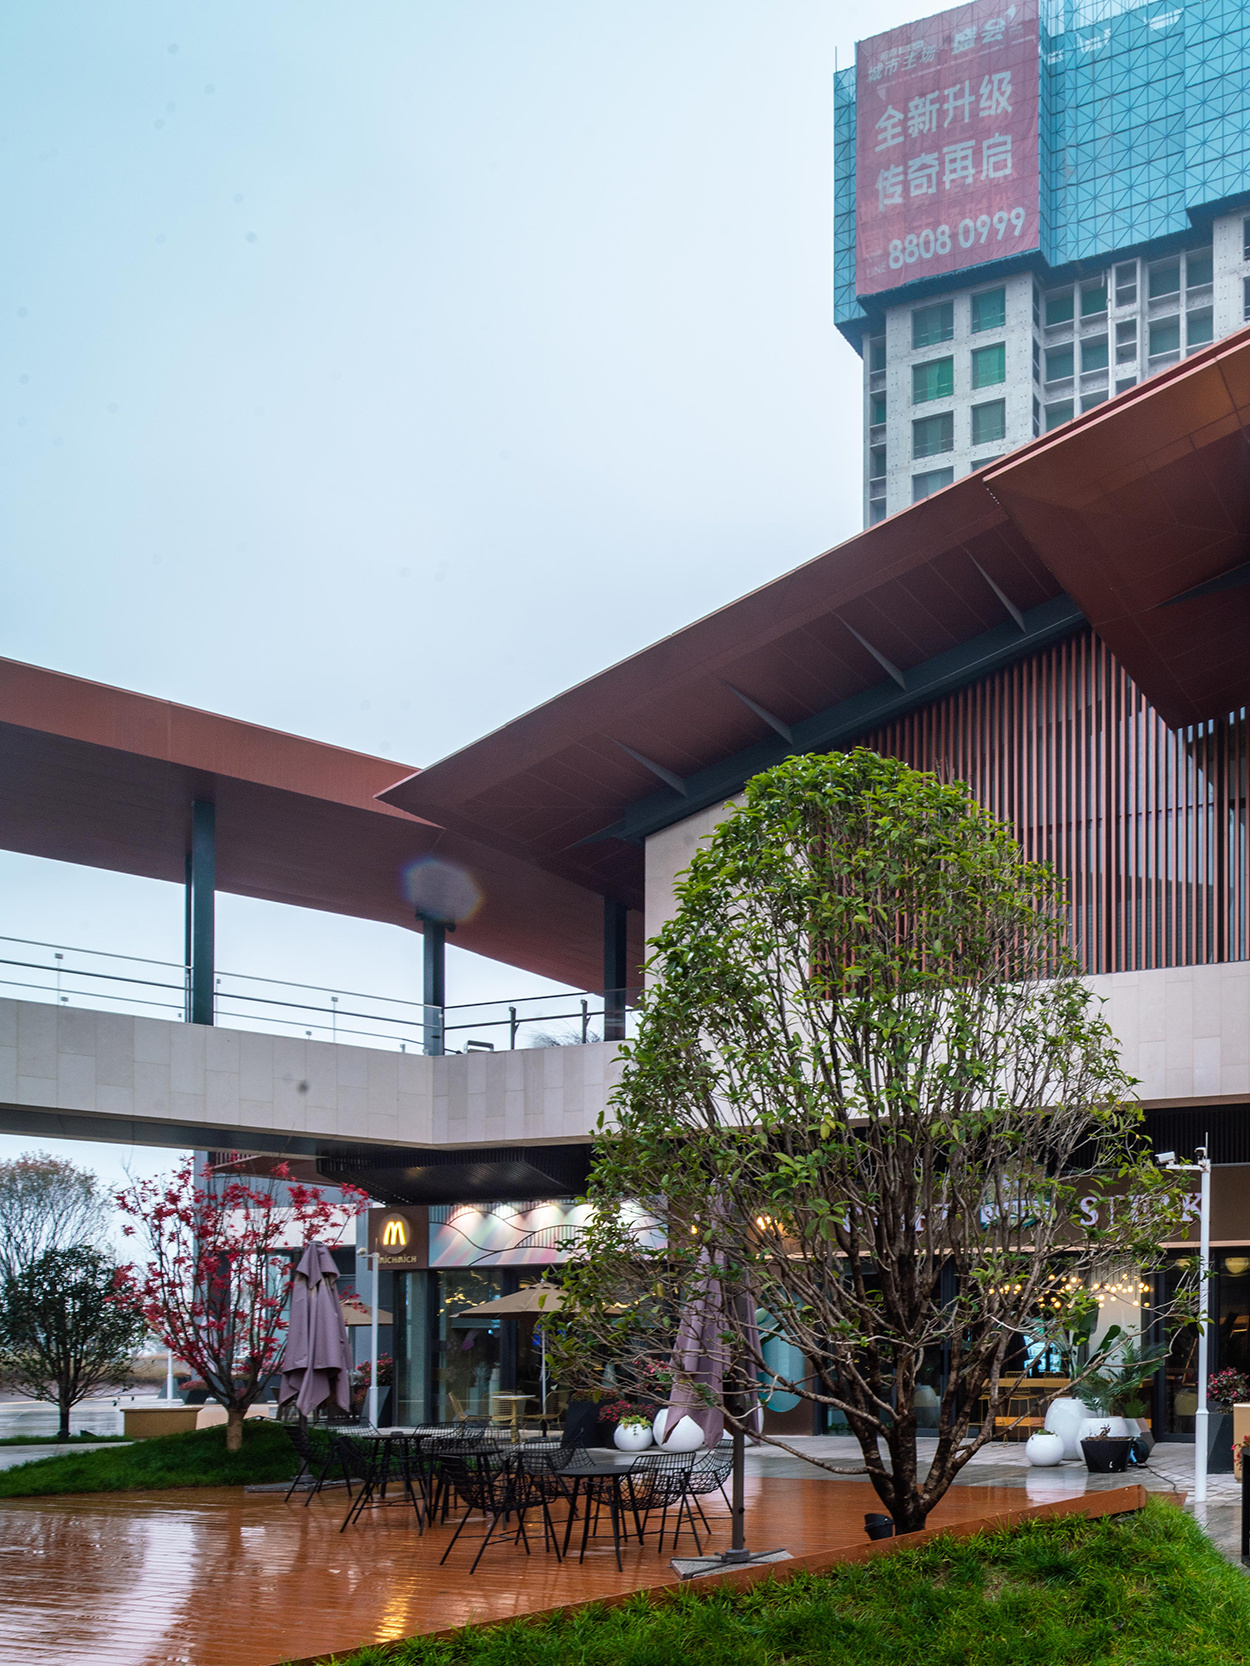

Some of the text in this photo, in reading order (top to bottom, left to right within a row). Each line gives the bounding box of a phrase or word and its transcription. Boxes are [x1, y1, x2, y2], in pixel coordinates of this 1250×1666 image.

[951, 17, 1006, 55] 盛会
[875, 71, 1013, 152] 全新升级
[875, 133, 1013, 213] 传奇再启
[889, 207, 1026, 270] 8808 0999
